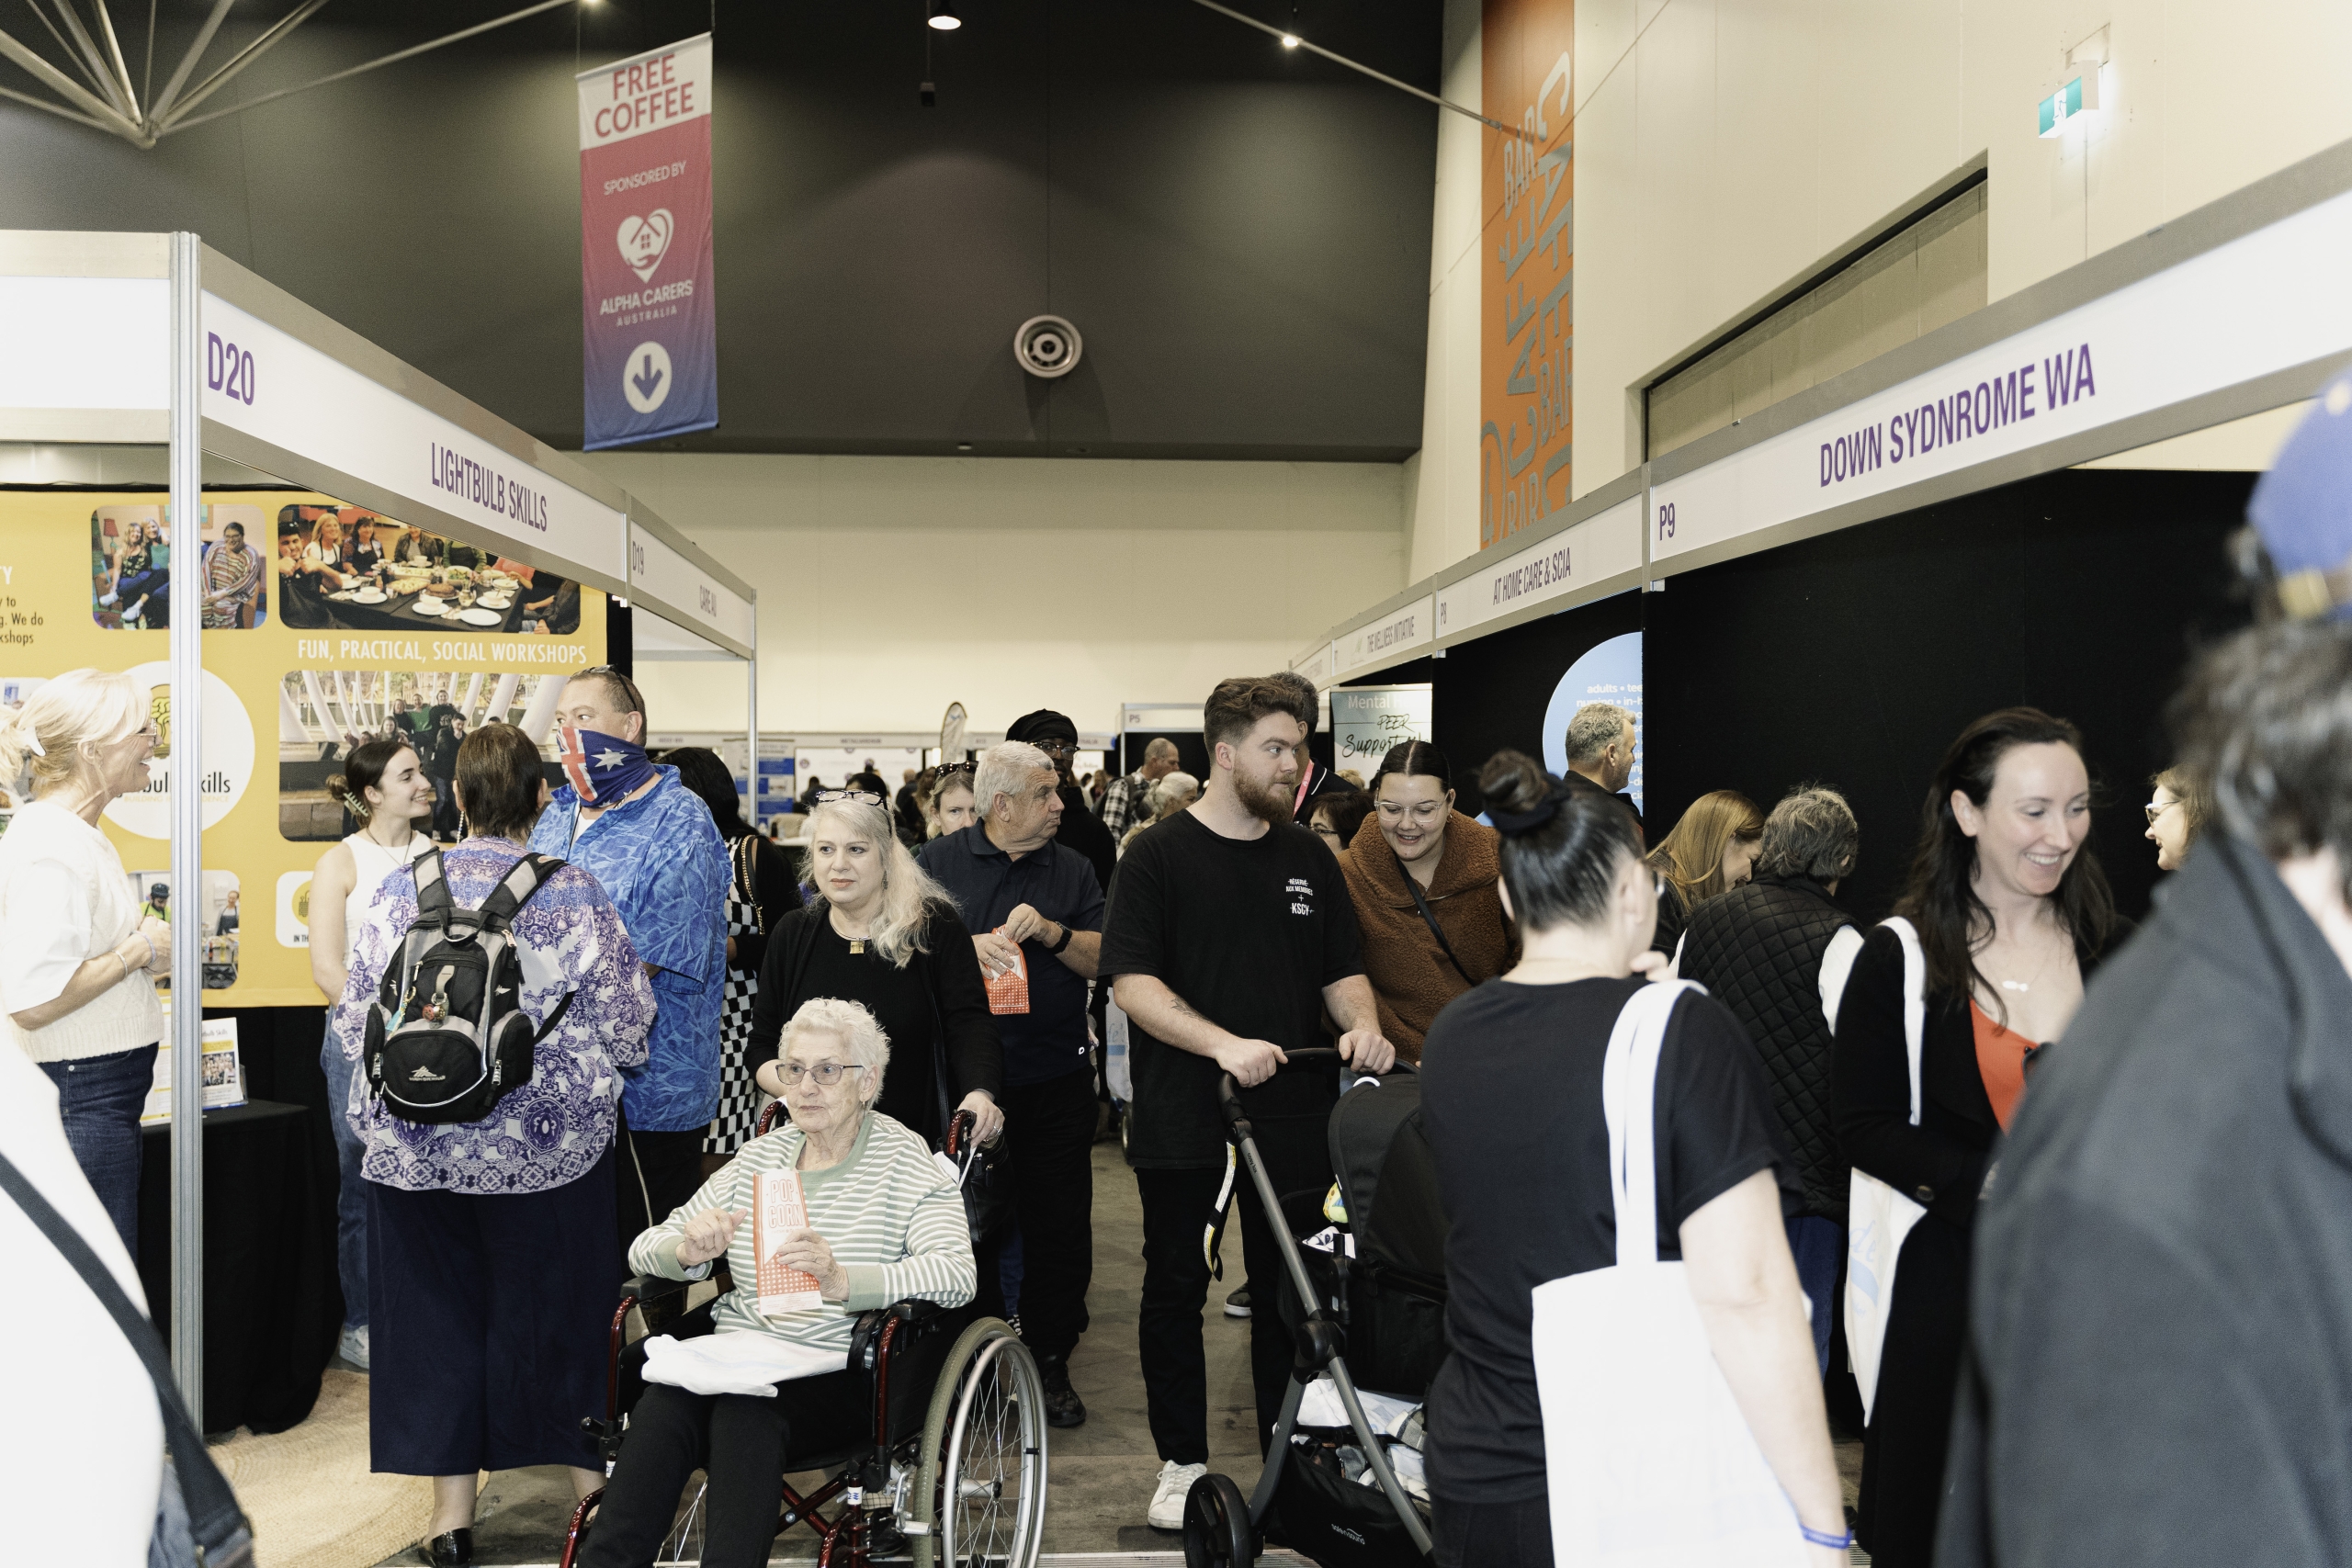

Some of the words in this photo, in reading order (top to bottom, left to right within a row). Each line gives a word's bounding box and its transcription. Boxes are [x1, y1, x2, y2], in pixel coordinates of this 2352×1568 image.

[613, 53, 675, 101] FREE
[594, 81, 695, 138] COFFEE
[1504, 105, 1536, 221] BAR
[604, 165, 671, 196] SPONSORED
[671, 160, 686, 180] BY
[600, 291, 641, 315] ALPHA
[642, 279, 693, 305] CARERS
[616, 305, 677, 327] AUSTRALIA
[208, 331, 254, 406] D20
[1820, 422, 1883, 488] DOWN
[1889, 364, 2036, 465] SYDNROME
[2043, 343, 2096, 412] WA
[431, 442, 505, 514] LIGHTBULB
[509, 479, 548, 533] SKILLS
[1659, 502, 1676, 541] P9
[632, 540, 644, 576] D19
[0, 566, 13, 585] Y
[1493, 578, 1501, 606] AT
[1502, 568, 1522, 603] HOME
[1523, 560, 1544, 595] CARE
[1544, 558, 1551, 586] &
[1552, 547, 1571, 583] SCIA
[6, 595, 17, 607] to
[1440, 602, 1447, 626] P8
[11, 613, 28, 626] We
[30, 611, 44, 626] do
[1393, 615, 1415, 644] INITIATIVE
[298, 638, 334, 662] FUN,
[340, 639, 427, 664] PRACTICAL,
[434, 641, 487, 662] SOCIAL
[492, 643, 587, 664] WORKSHOPS
[1348, 694, 1390, 709] Mental
[1587, 683, 1618, 694] adults
[1377, 713, 1413, 732] PEER
[770, 1179, 794, 1203] POP
[768, 1203, 803, 1228] CORN
